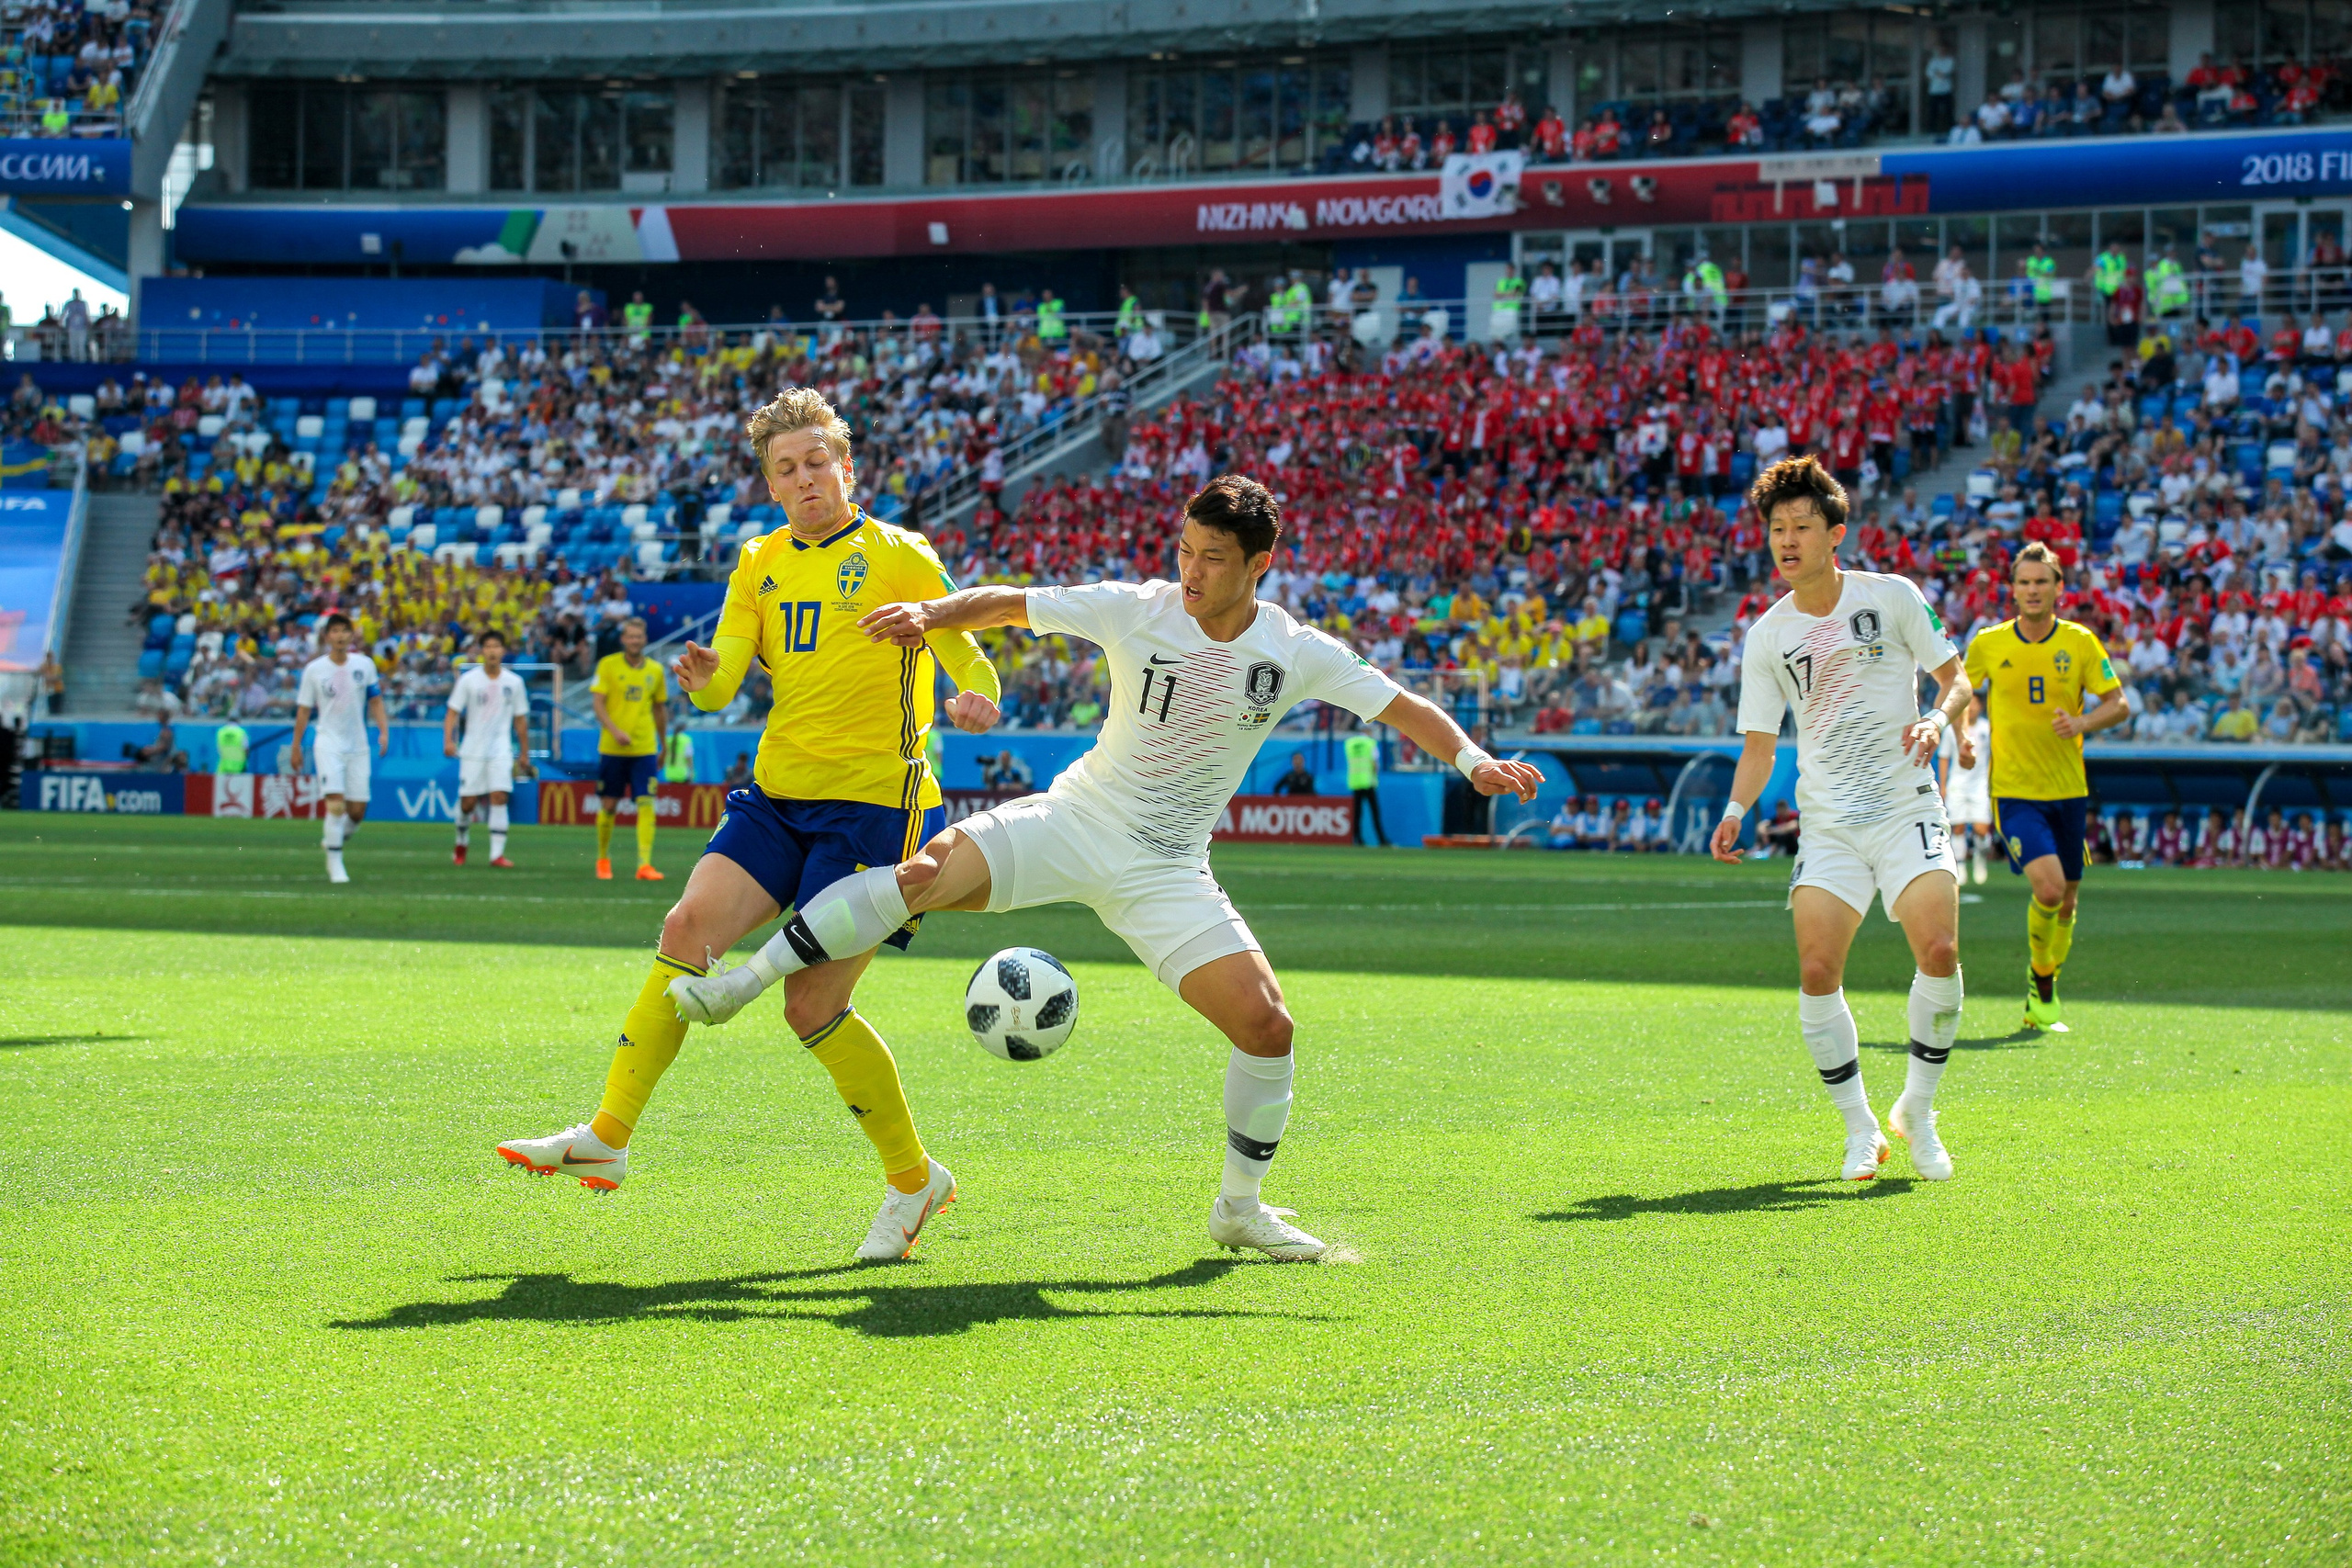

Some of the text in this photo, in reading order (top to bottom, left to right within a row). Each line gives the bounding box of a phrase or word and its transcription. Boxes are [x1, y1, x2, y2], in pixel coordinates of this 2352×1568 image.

[0, 153, 89, 180] ССИИ
[2241, 152, 2352, 185] 2018 FI
[1317, 195, 1444, 226] NOVGORO
[758, 583, 779, 596] adidas
[779, 601, 822, 653] 10
[1785, 654, 1812, 700] 17
[2029, 676, 2044, 704] 8
[1138, 667, 1177, 723] 11
[397, 779, 460, 818] viv
[1240, 804, 1351, 836] MOTORS
